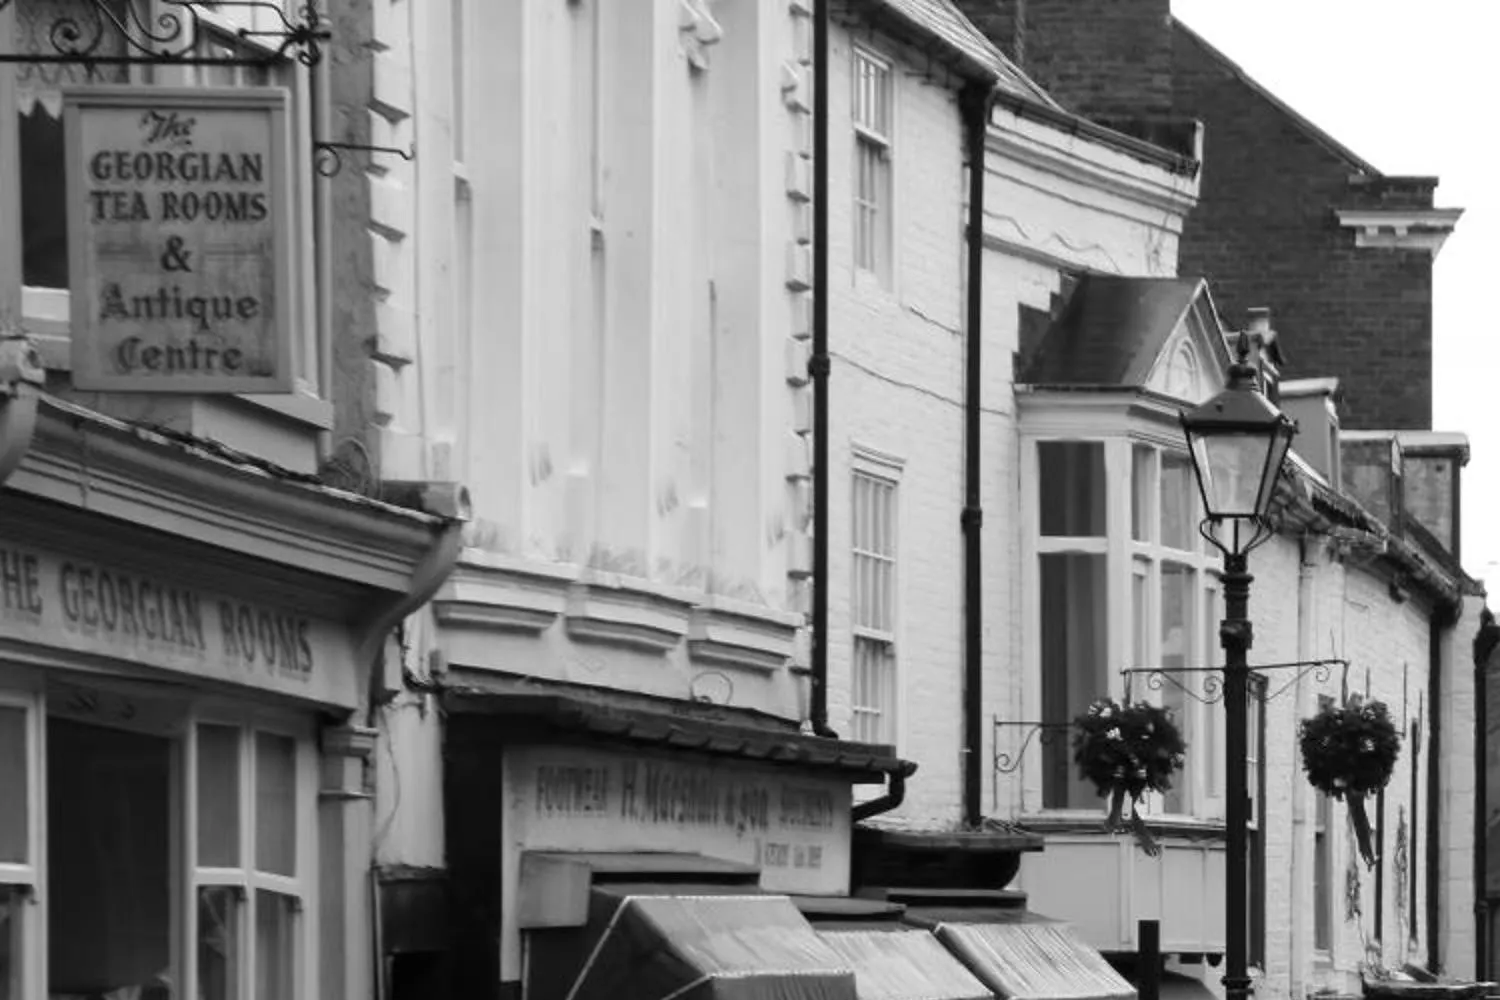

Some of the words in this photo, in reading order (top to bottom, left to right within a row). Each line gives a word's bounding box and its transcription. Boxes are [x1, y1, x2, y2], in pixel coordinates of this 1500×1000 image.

[140, 109, 197, 146] The
[89, 150, 264, 183] GEORGIAN
[88, 190, 151, 222] TEA
[160, 191, 269, 222] ROOMS
[160, 235, 192, 273] &
[100, 282, 261, 331] Antique
[115, 336, 244, 374] Centre
[0, 548, 44, 616] HE
[59, 560, 207, 652] GEORGIAN
[217, 599, 314, 674] ROOMS
